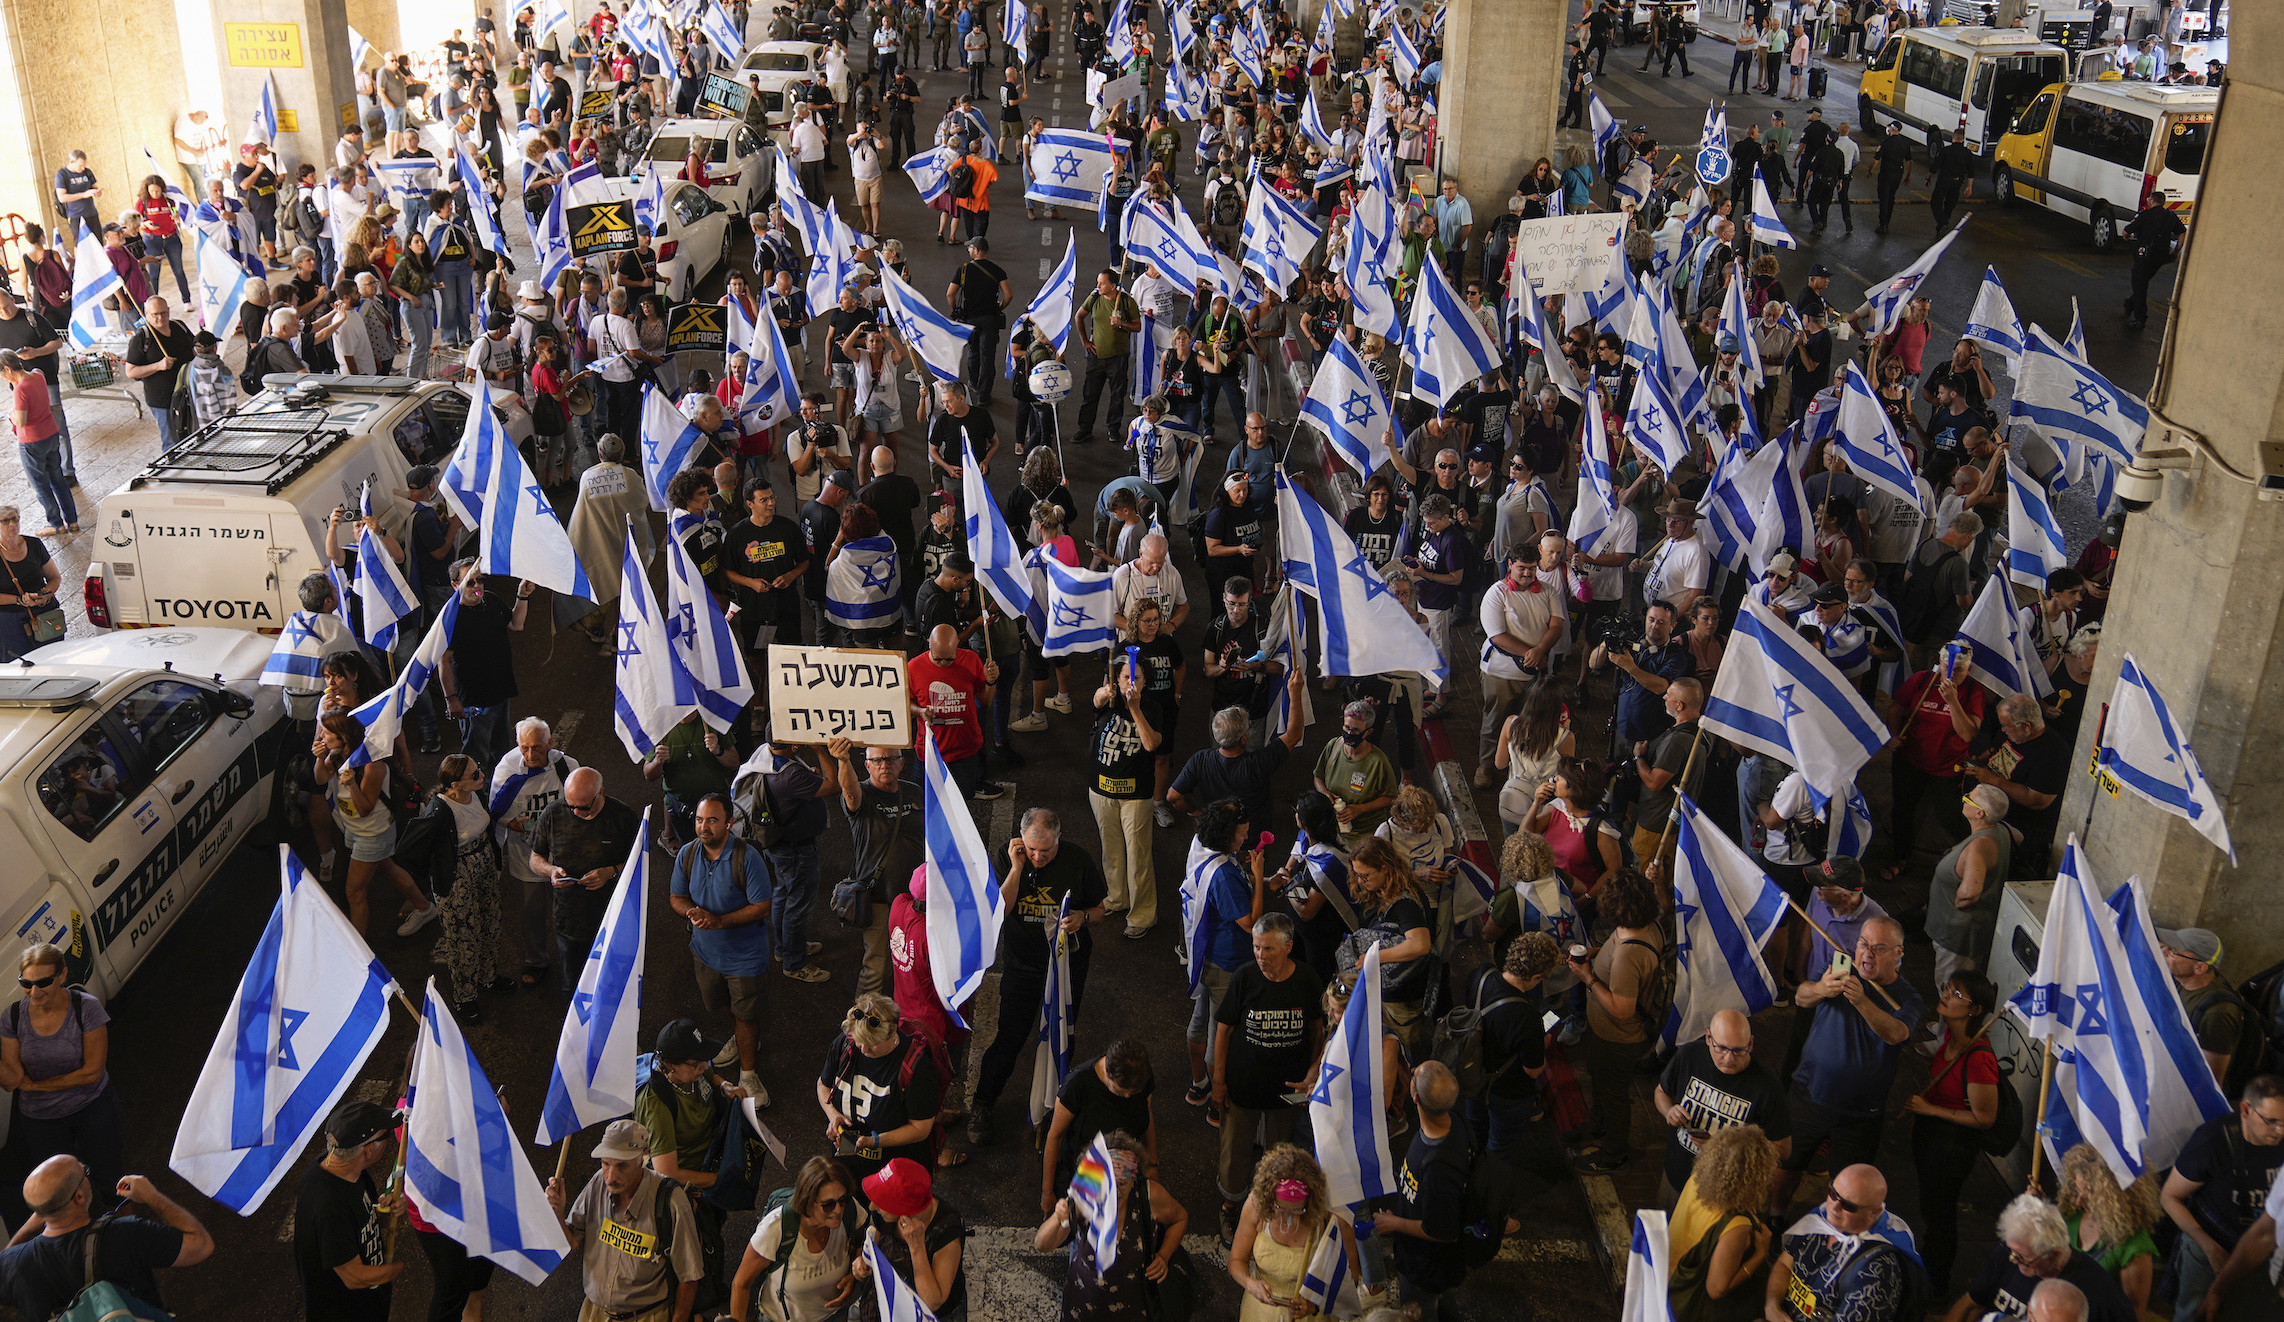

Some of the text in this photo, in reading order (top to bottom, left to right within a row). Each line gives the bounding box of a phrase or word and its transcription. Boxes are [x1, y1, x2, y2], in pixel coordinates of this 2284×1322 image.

[236, 29, 287, 42] עצירה
[239, 47, 291, 61] אסורה
[707, 74, 749, 97] DEMOCRACY
[704, 86, 726, 106] WILL
[727, 95, 747, 113] WIN
[574, 229, 635, 250] KAPLANFORCE
[1520, 224, 1551, 241] מקום
[669, 332, 723, 345] KAPLANFORCE
[145, 523, 265, 540] משמר הגבול
[1361, 533, 1391, 549] דמו
[154, 598, 273, 620] TOYOTA
[780, 652, 900, 690] ממשלה
[187, 764, 242, 840] משמר
[105, 845, 170, 935] הגבול
[130, 887, 175, 949] POLICE
[1247, 1009, 1303, 1021] אין דמוקרטיה
[1261, 1020, 1303, 1030] עם כיבוש
[1687, 1079, 1749, 1121] STRAIGHT
[601, 1230, 649, 1256] חורבן וביזה
[610, 1223, 643, 1245] ממשלת
